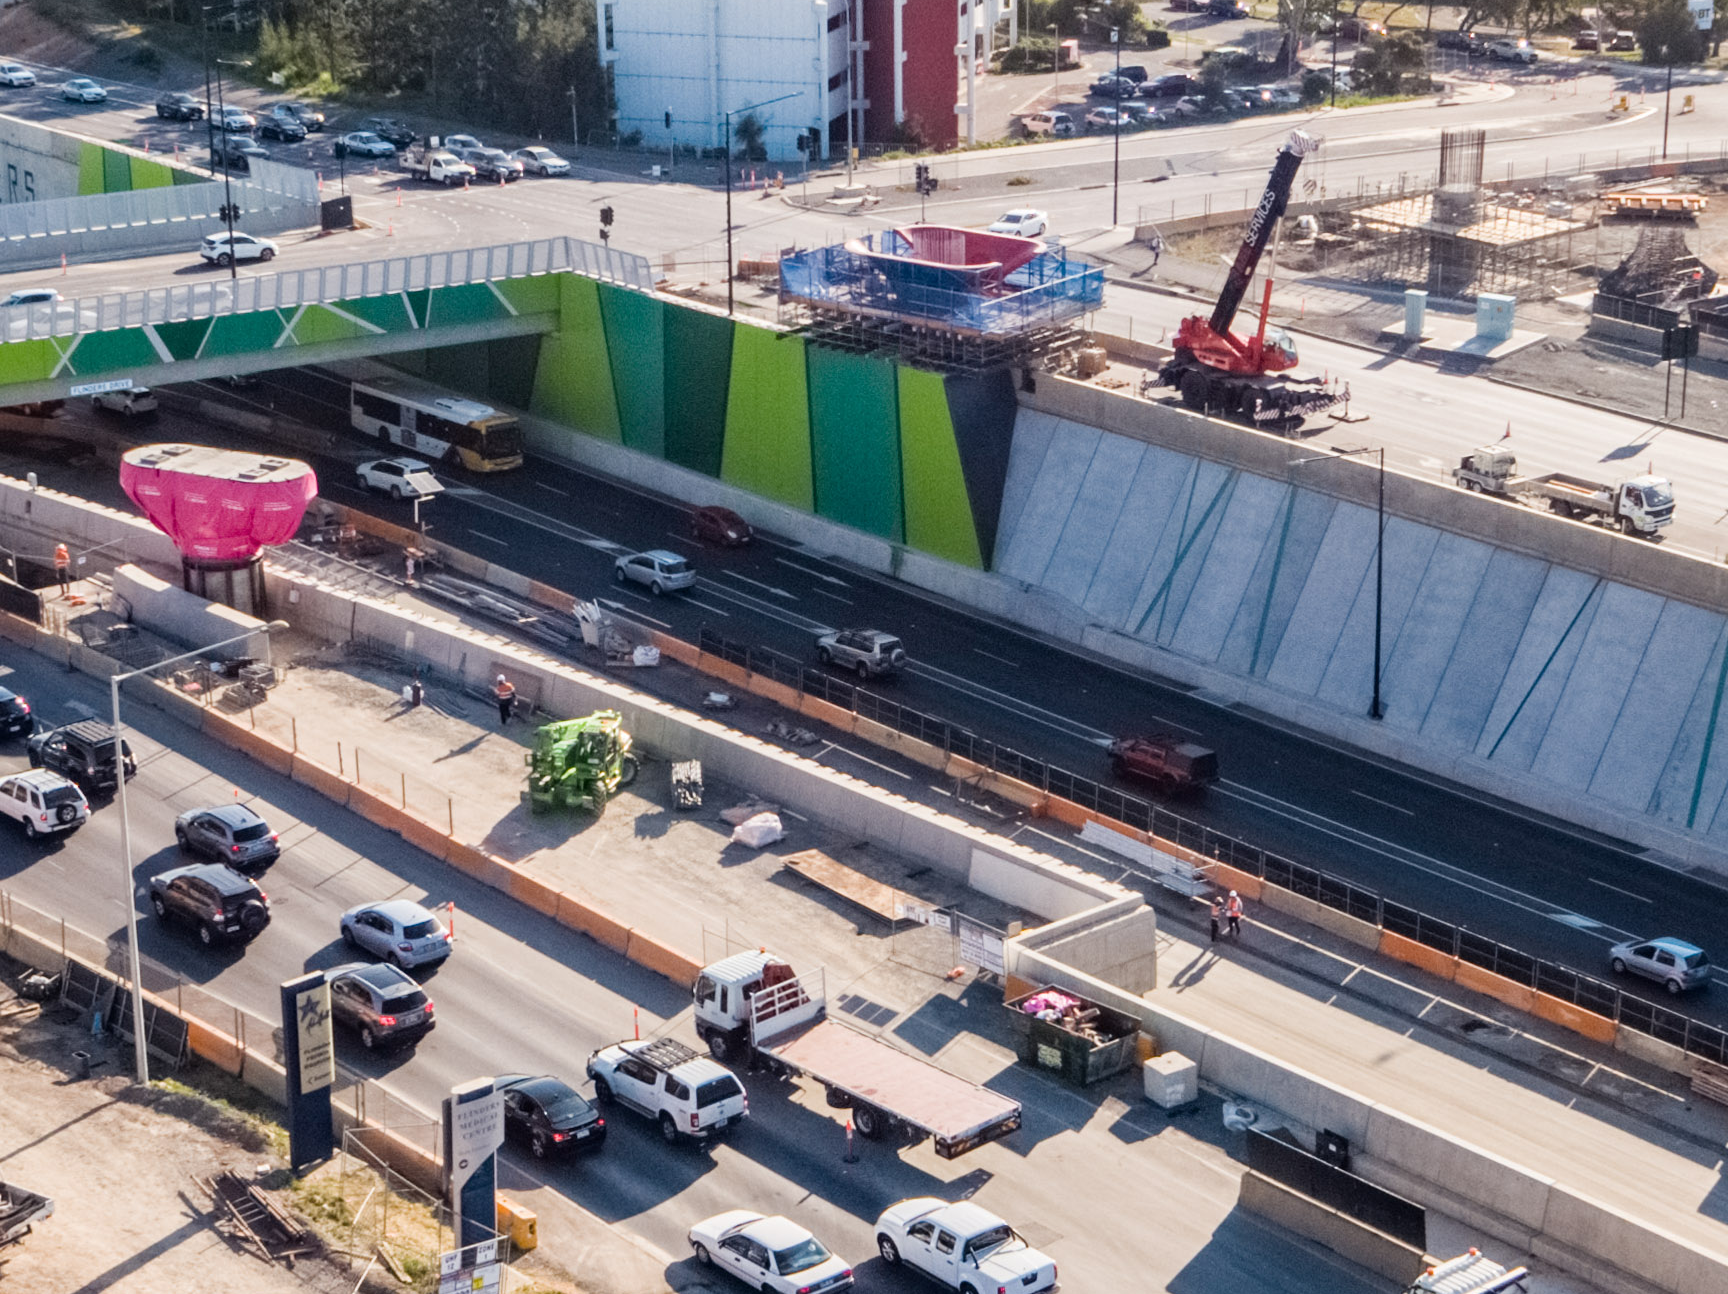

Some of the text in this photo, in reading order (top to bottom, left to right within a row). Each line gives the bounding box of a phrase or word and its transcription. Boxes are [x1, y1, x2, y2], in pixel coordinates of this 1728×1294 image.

[1244, 188, 1276, 247] SERVICES
[72, 379, 130, 395] FLINDERS DRIVE
[457, 1101, 500, 1121] FLINDERS
[459, 1112, 498, 1130] MEDICAL
[462, 1123, 497, 1140] CENTRE
